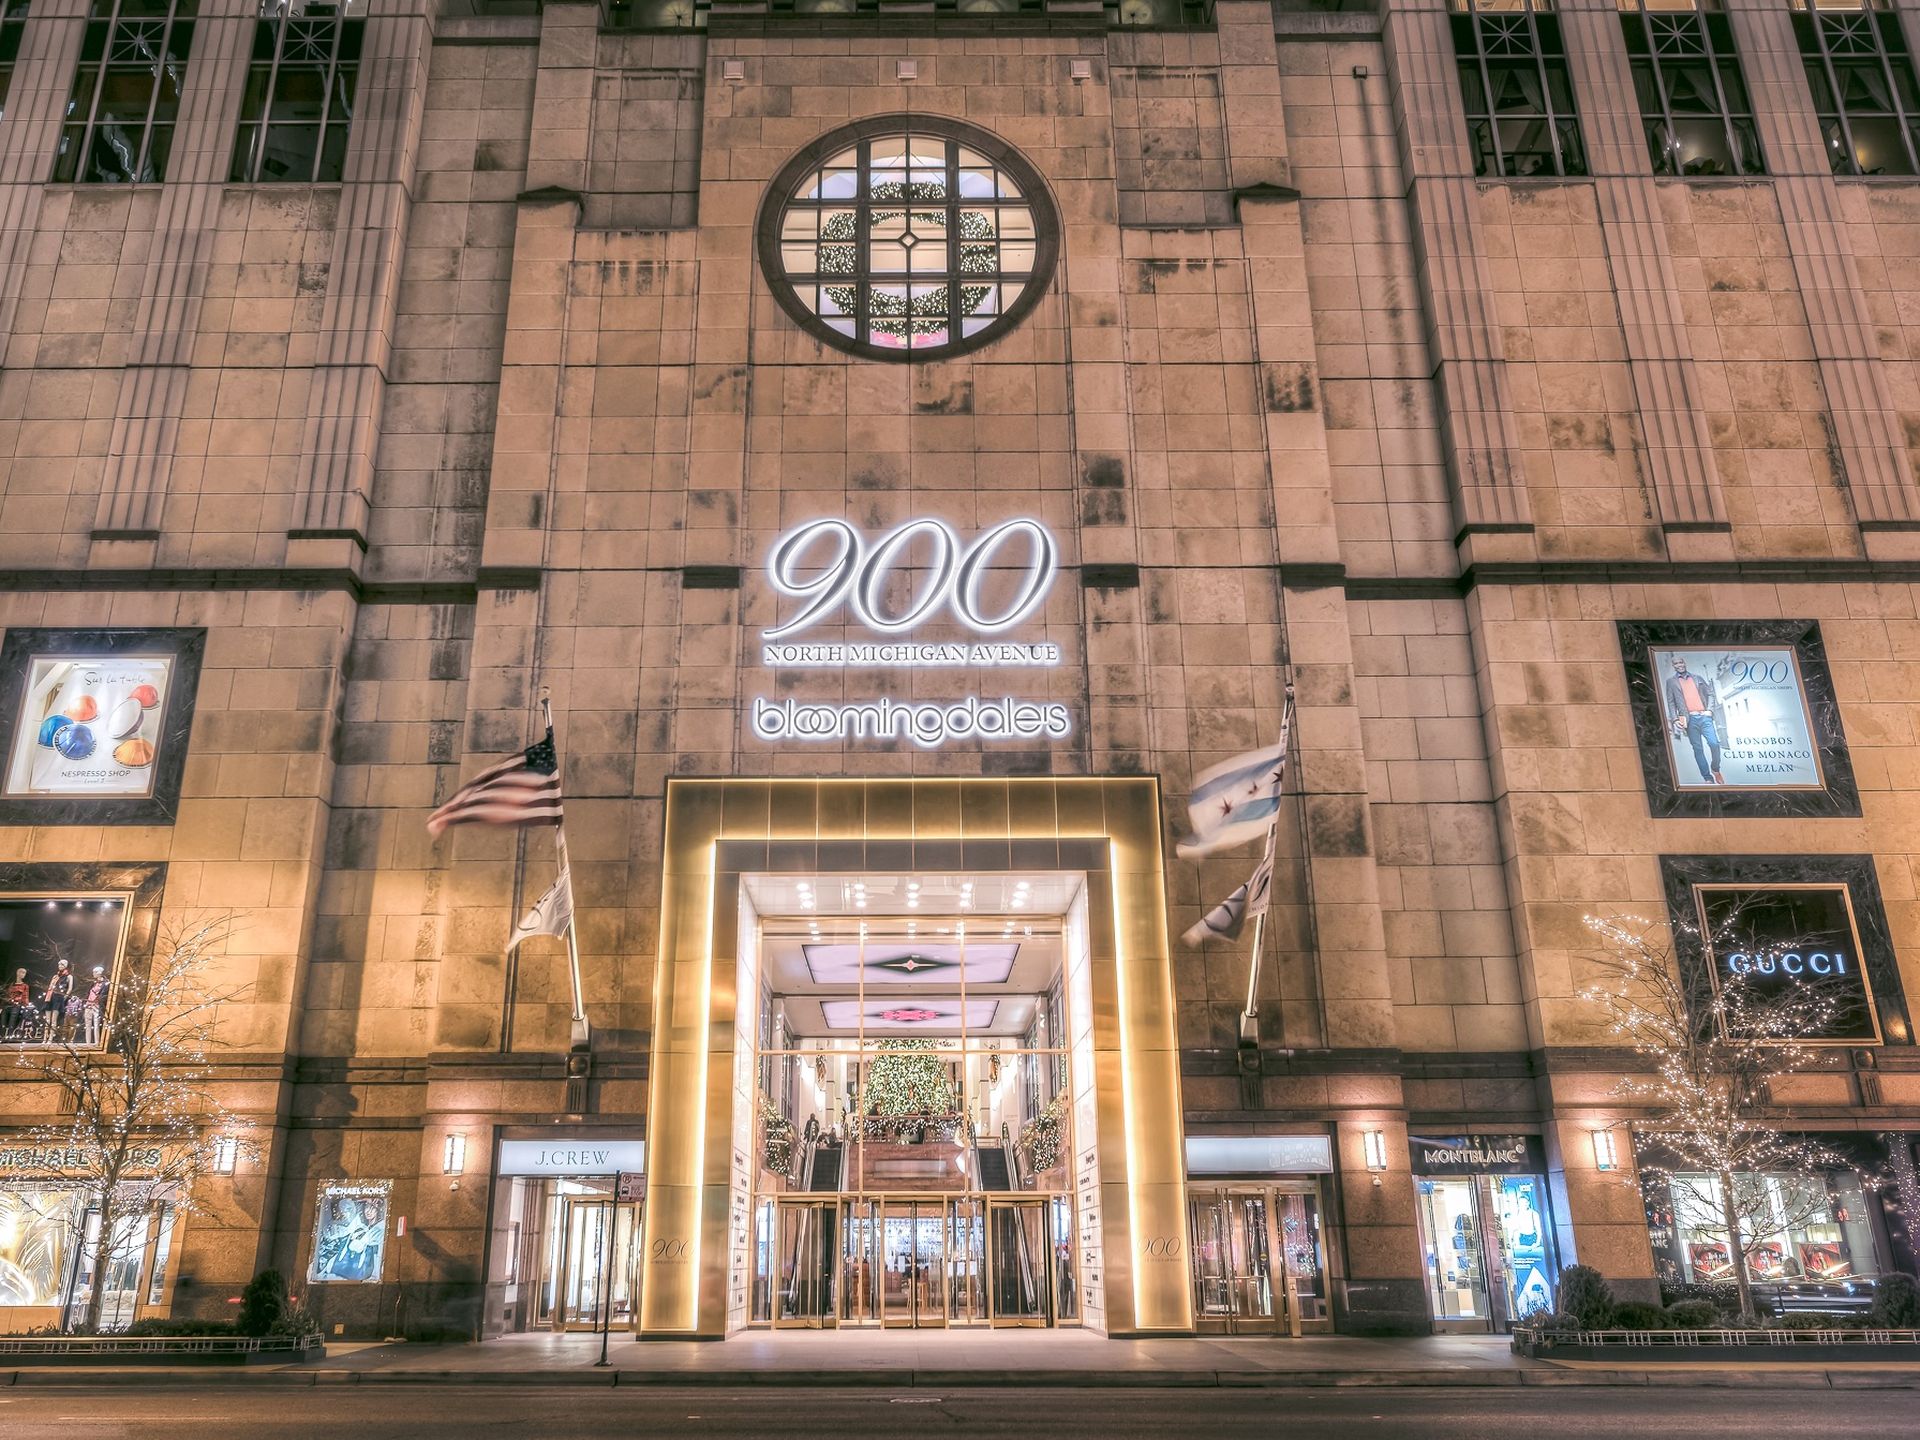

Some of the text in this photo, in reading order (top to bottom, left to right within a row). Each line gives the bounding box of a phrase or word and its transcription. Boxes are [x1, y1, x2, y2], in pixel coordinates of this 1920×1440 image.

[762, 519, 1054, 638] 900
[767, 645, 1057, 661] NORTH MICHIGAN AVENUE
[1731, 660, 1788, 684] 900
[756, 698, 1069, 743] bloomingdale's
[1735, 736, 1793, 745] BONOBOS
[1723, 750, 1811, 759] CLUB MONACO
[60, 769, 131, 778] NESPRESSO SHOP
[1745, 764, 1794, 773] MEZLAN
[1728, 953, 1846, 974] GUCCI
[535, 1151, 610, 1166] J.CREW
[1424, 1149, 1520, 1164] MONTBLANC
